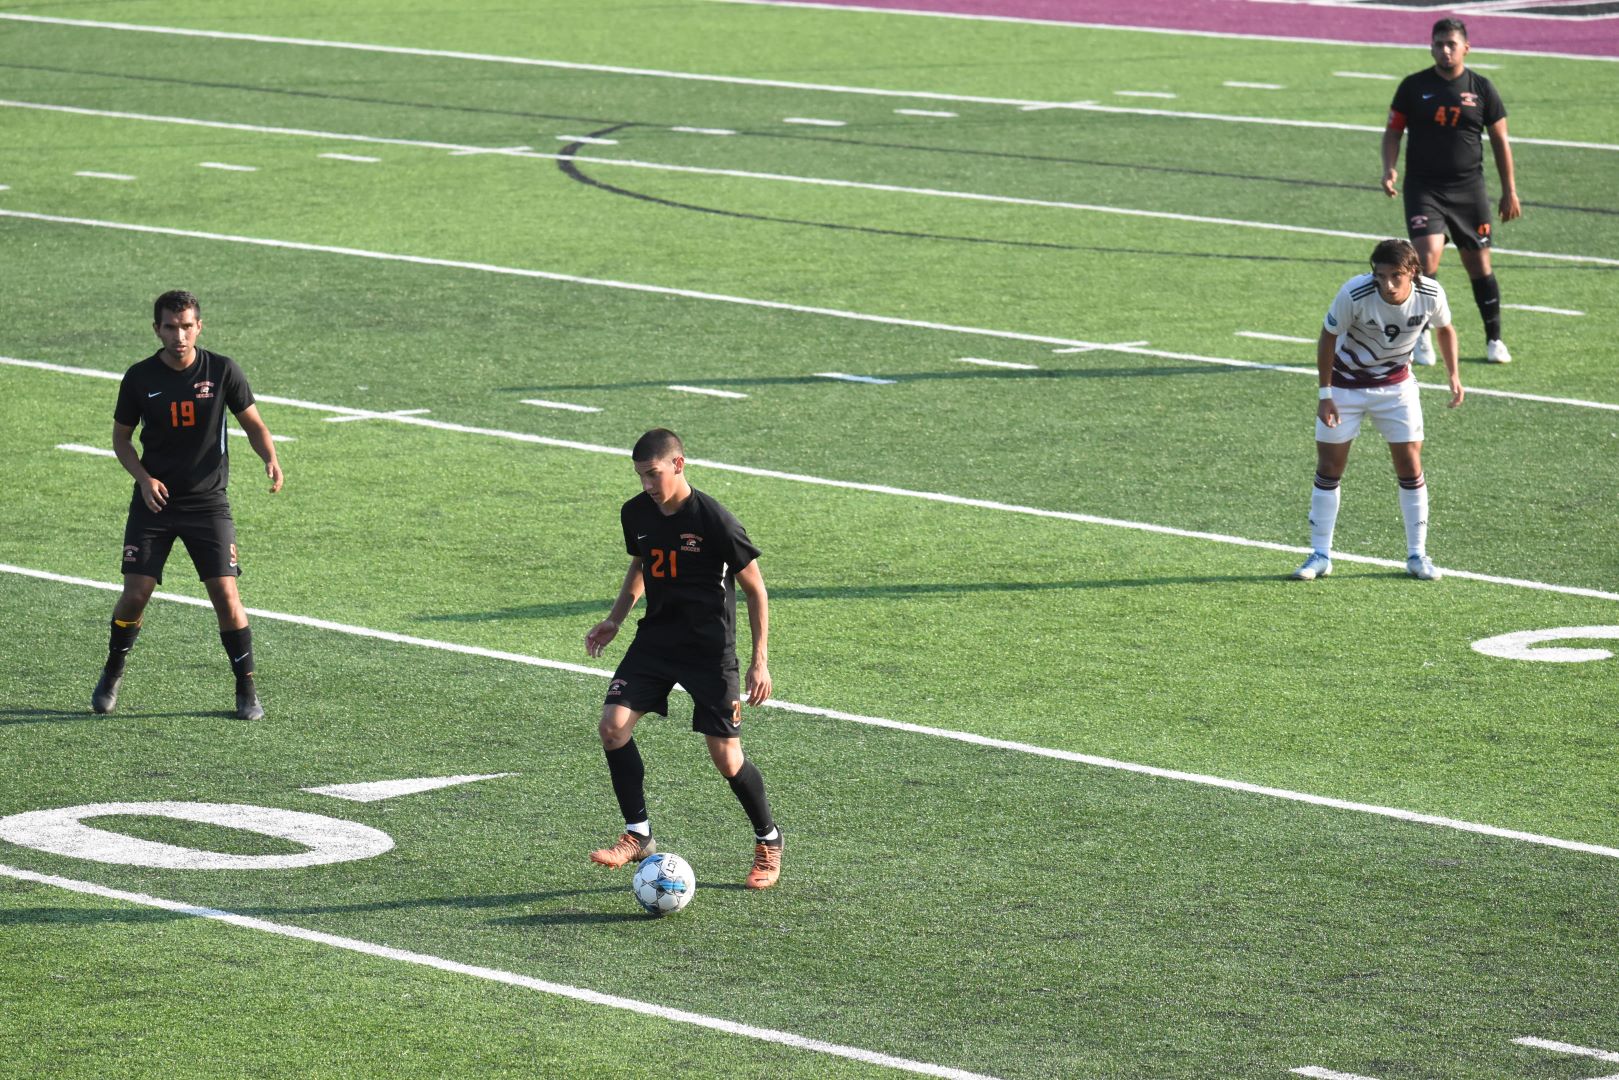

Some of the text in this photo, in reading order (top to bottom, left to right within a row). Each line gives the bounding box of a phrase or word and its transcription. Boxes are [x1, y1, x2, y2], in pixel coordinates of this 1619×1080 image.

[1434, 106, 1461, 127] 47
[1385, 324, 1400, 343] 9
[170, 400, 195, 427] 19
[651, 549, 677, 577] 21
